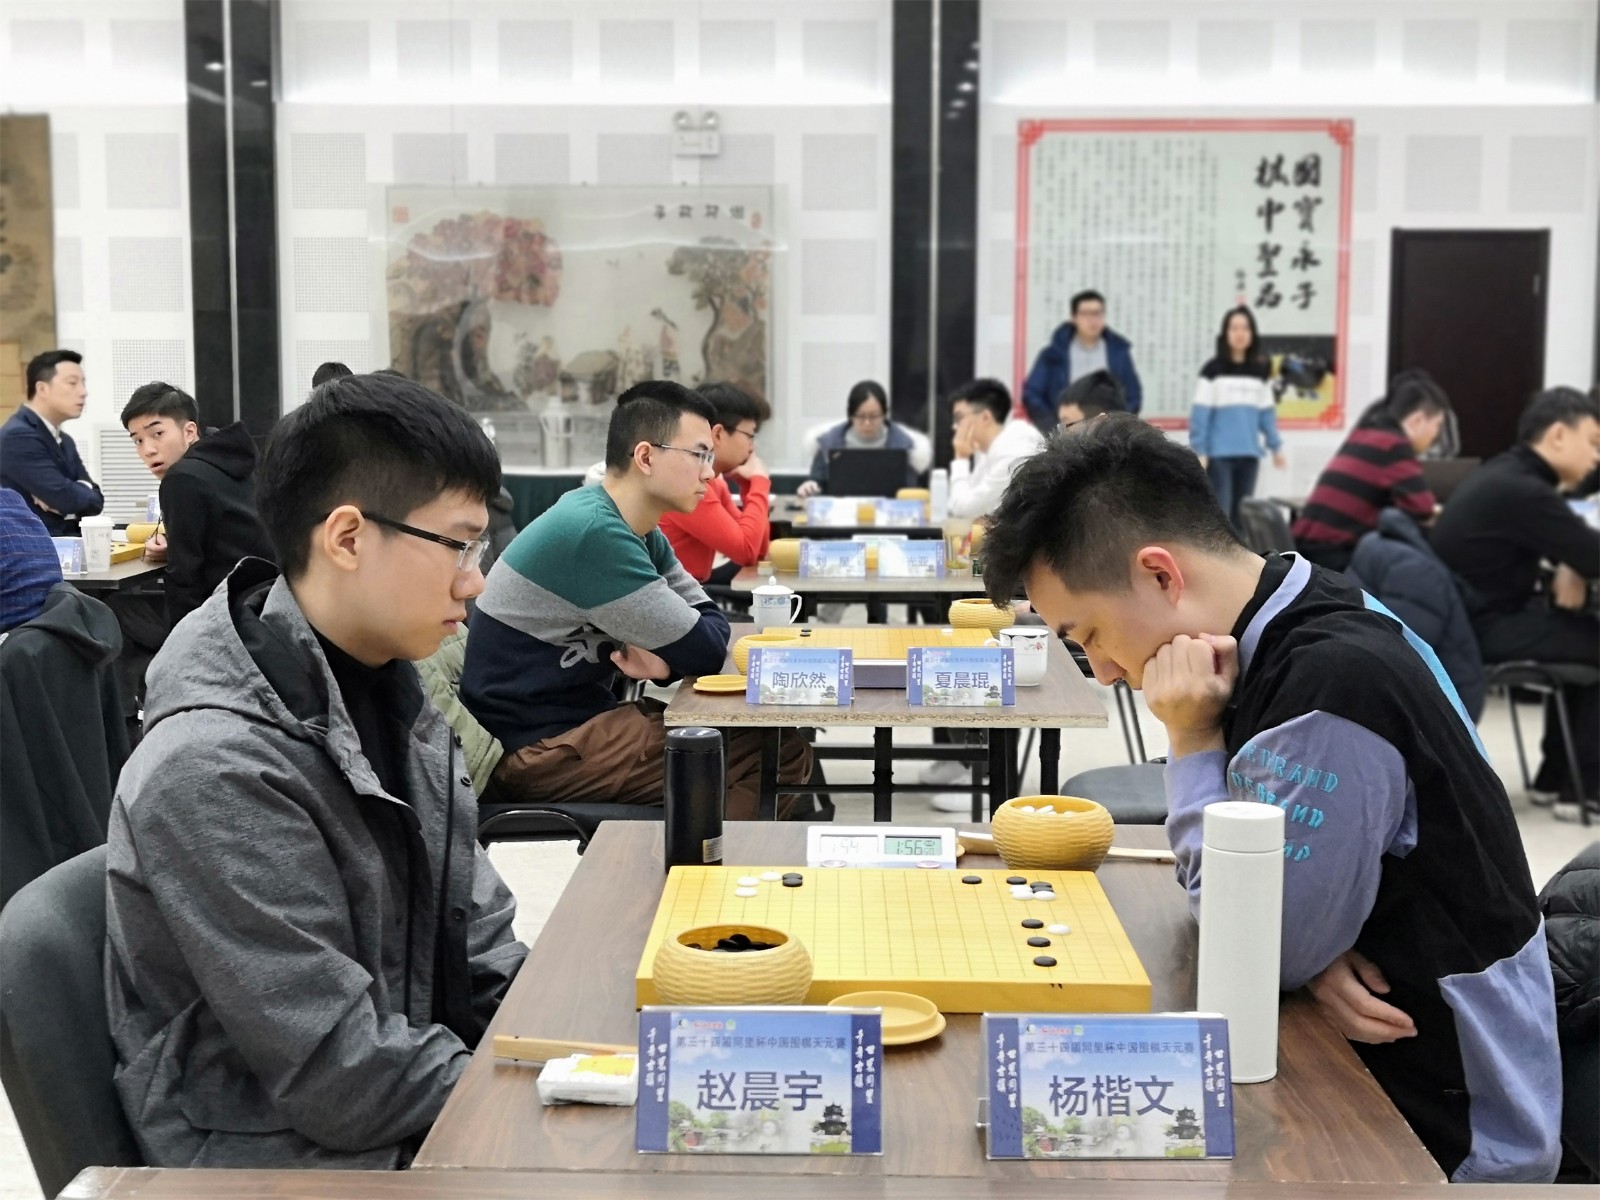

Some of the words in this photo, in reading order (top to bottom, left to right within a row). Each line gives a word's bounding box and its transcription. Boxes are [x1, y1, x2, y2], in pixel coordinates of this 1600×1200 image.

[772, 671, 827, 689] 陶欣然
[934, 671, 990, 689] 夏晨琨
[897, 840, 923, 856] 1:56
[696, 1069, 823, 1112] 赵晨宇
[1048, 1074, 1175, 1117] 杨楷文
